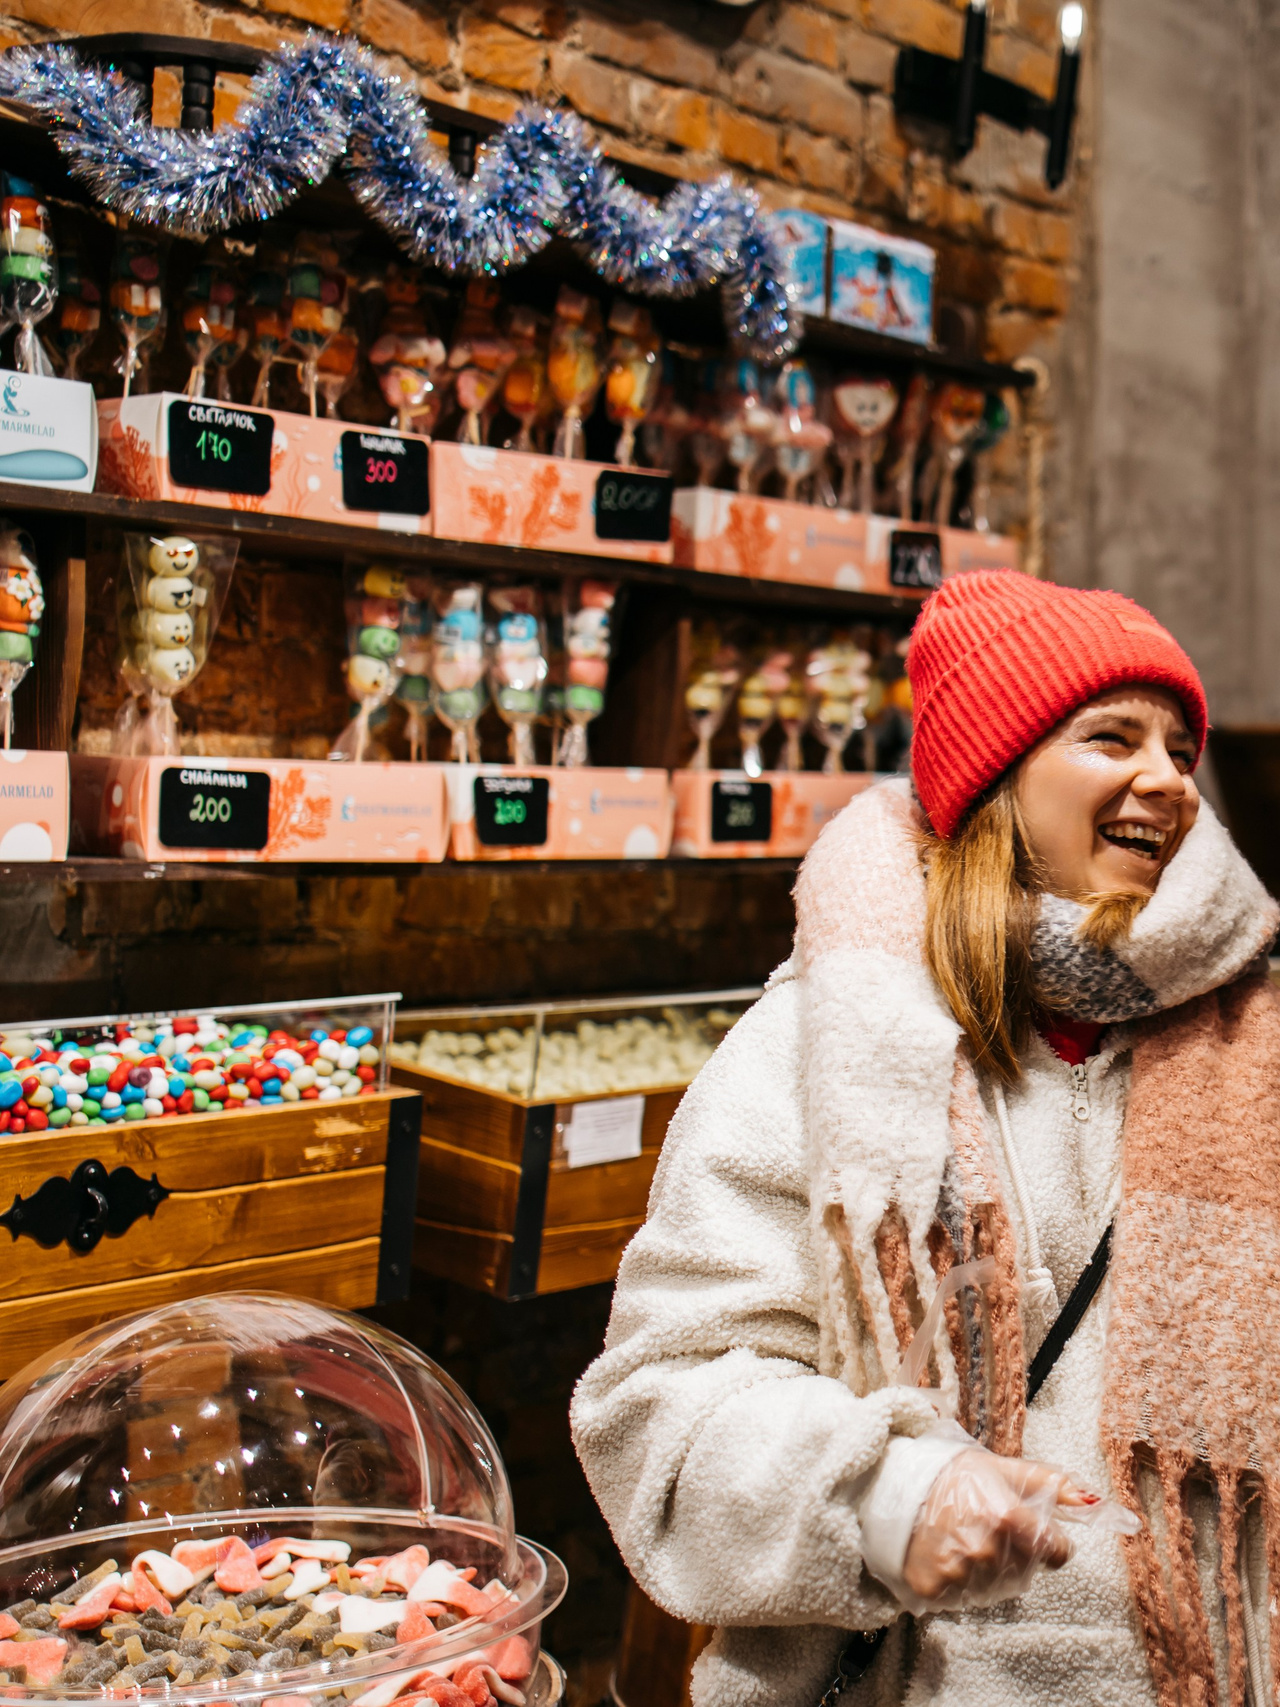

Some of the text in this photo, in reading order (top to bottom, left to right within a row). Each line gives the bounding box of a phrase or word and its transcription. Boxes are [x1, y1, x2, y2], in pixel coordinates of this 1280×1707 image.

[0, 419, 55, 438] MARMELAD
[188, 405, 257, 433] СВЕТЛЯЧОК
[196, 430, 232, 462] 170
[365, 457, 398, 483] 300
[180, 769, 248, 789] СМАЙЛИКИ
[189, 793, 232, 823] 200
